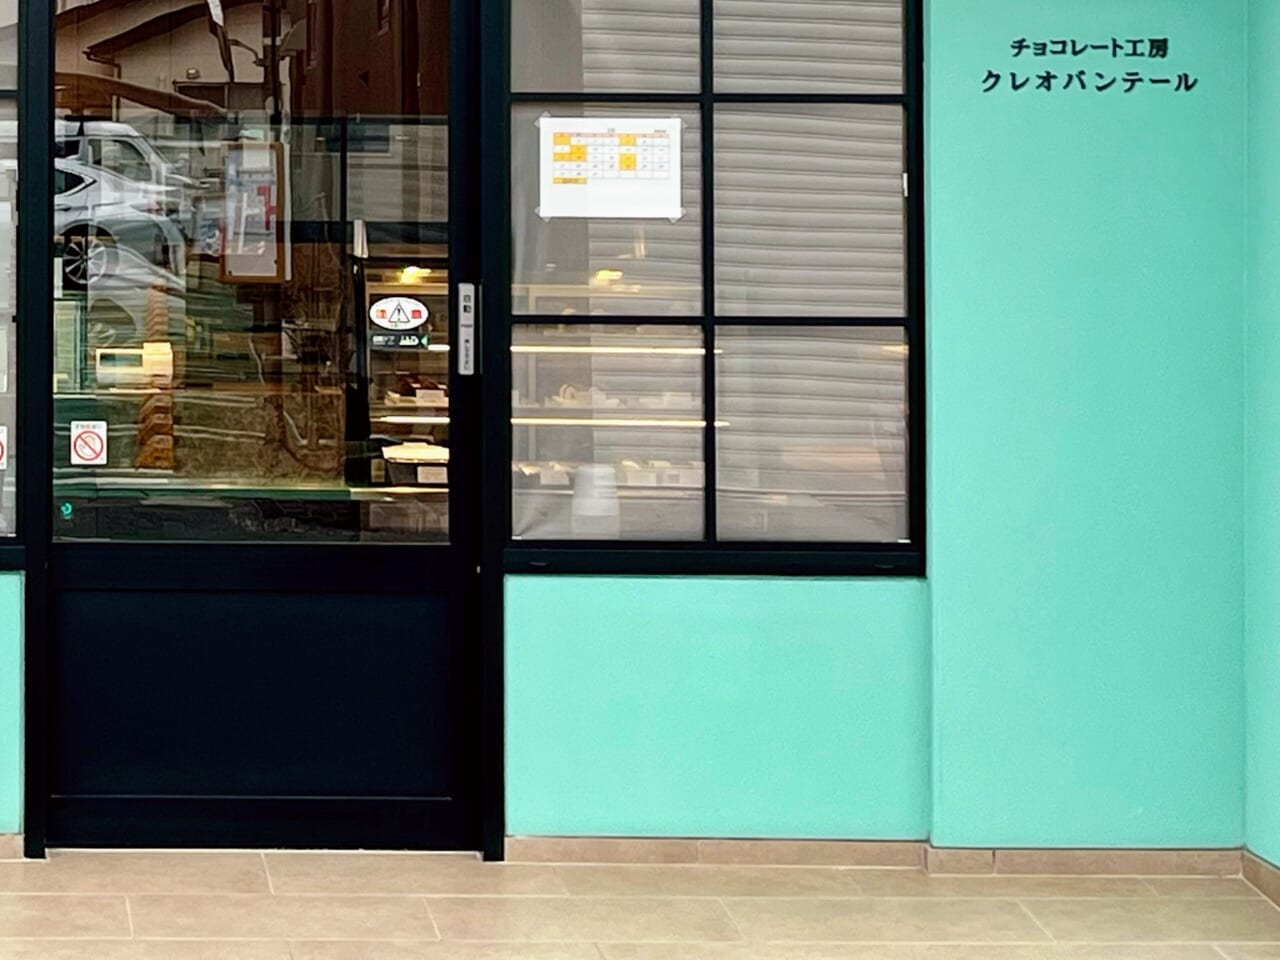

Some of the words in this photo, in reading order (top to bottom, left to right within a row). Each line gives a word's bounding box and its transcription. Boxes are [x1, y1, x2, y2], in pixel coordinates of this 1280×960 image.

[1010, 37, 1169, 58] チョコレート工房
[982, 69, 1198, 93] クレオバンテール
